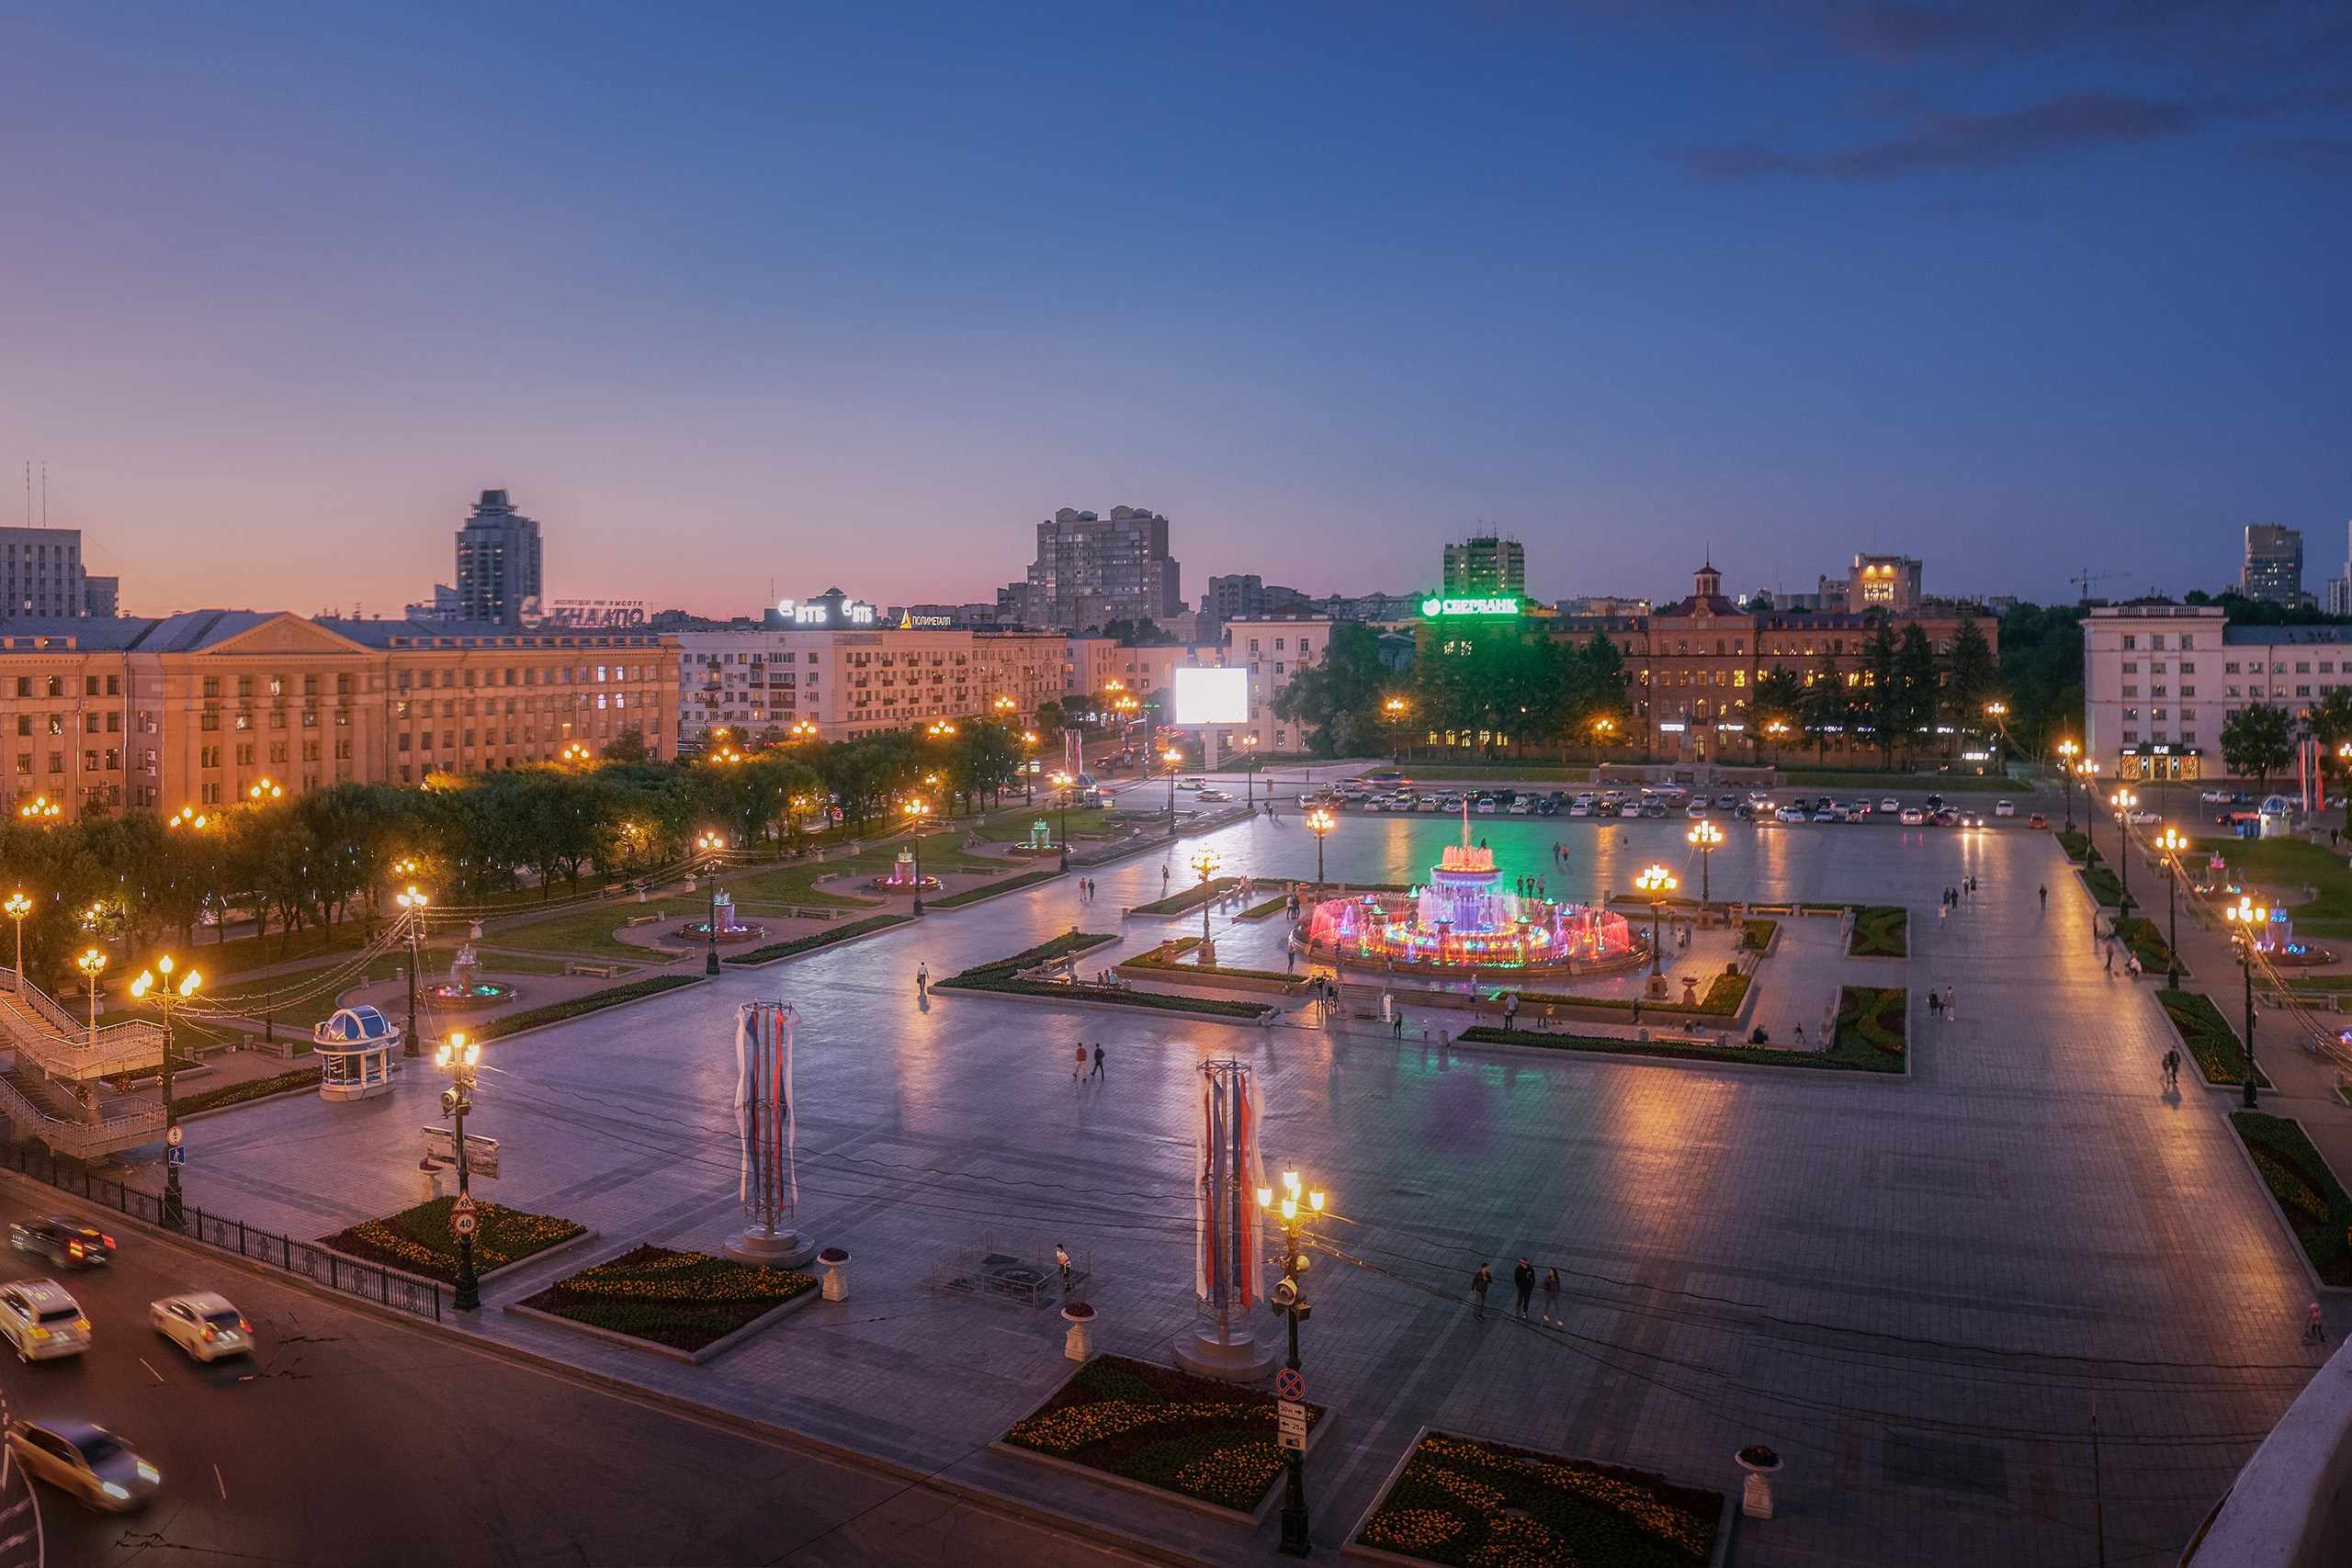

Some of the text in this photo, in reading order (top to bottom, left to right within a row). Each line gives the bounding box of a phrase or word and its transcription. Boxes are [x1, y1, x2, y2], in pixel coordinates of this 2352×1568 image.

[796, 606, 826, 623] ВТБ
[853, 606, 872, 623] ВТБ
[1442, 599, 1518, 615] СБЕРБАНК
[551, 608, 644, 626] КНААПО
[912, 615, 951, 626] ПОЛИМЕТАЛЛ
[459, 1219, 471, 1228] 40
